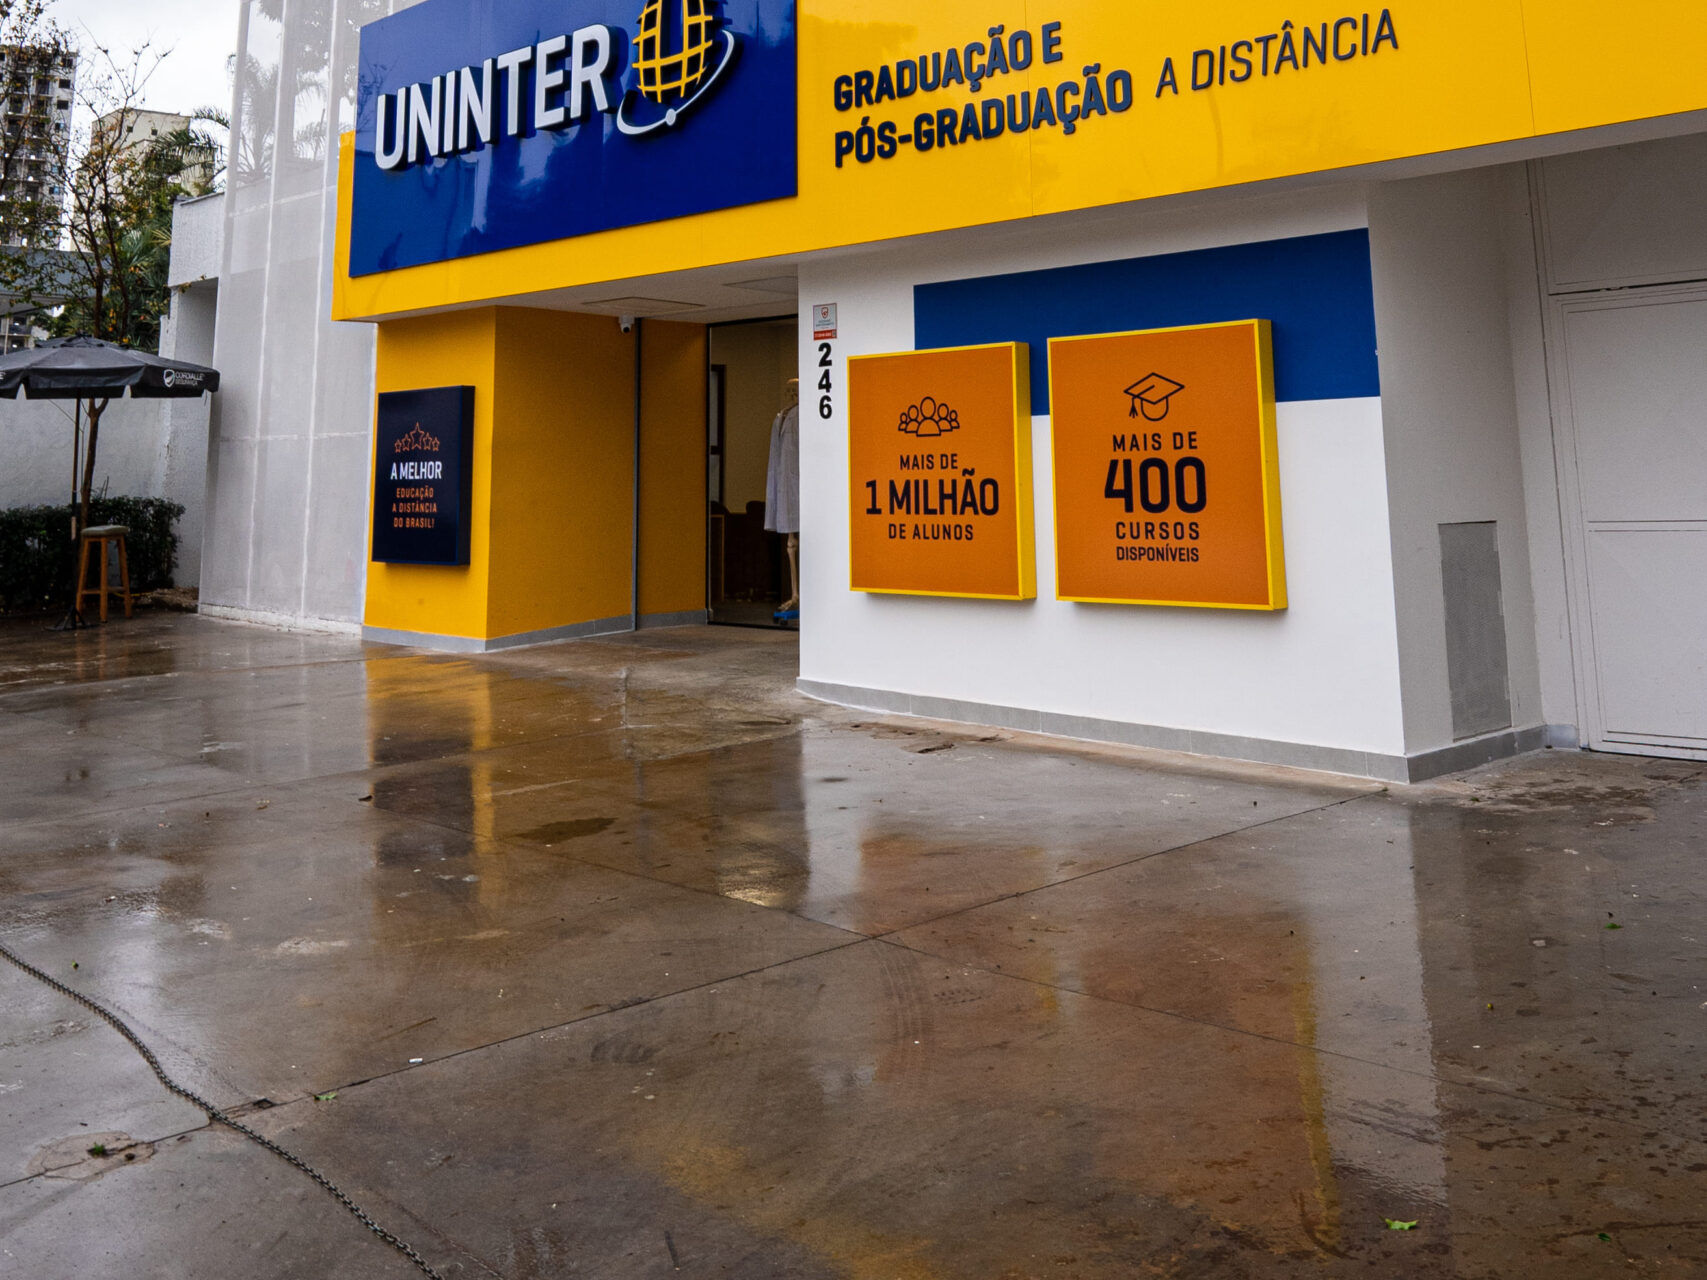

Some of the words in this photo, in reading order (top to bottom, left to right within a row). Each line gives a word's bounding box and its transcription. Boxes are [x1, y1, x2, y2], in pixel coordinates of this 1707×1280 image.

[1155, 57, 1178, 98] A
[1191, 8, 1399, 91] DISTÂNCIA
[834, 24, 1032, 111] GRADUAÇÃO
[1041, 21, 1063, 64] E
[375, 24, 613, 170] UNINTER
[835, 63, 1132, 168] PÓS-GRADUAÇÃO
[1112, 433, 1162, 452] MAIS
[1172, 431, 1198, 450] DE
[390, 463, 398, 480] A
[399, 461, 443, 480] MELHOR
[899, 454, 934, 470] MAIS
[940, 453, 959, 469] DE
[396, 485, 434, 501] EDUCAÇÃO
[865, 479, 882, 515] 1
[889, 467, 999, 516] MILHÃO
[1104, 456, 1207, 513] 400
[392, 503, 397, 513] A
[398, 501, 437, 513] DISTÂNCIA
[393, 517, 403, 528] DO
[405, 517, 435, 528] BRASIL!
[888, 523, 907, 539] DE
[912, 524, 974, 541] ALUNOS
[1115, 521, 1200, 540] CURSOS
[1116, 543, 1200, 562] DISPONÍVEIS
